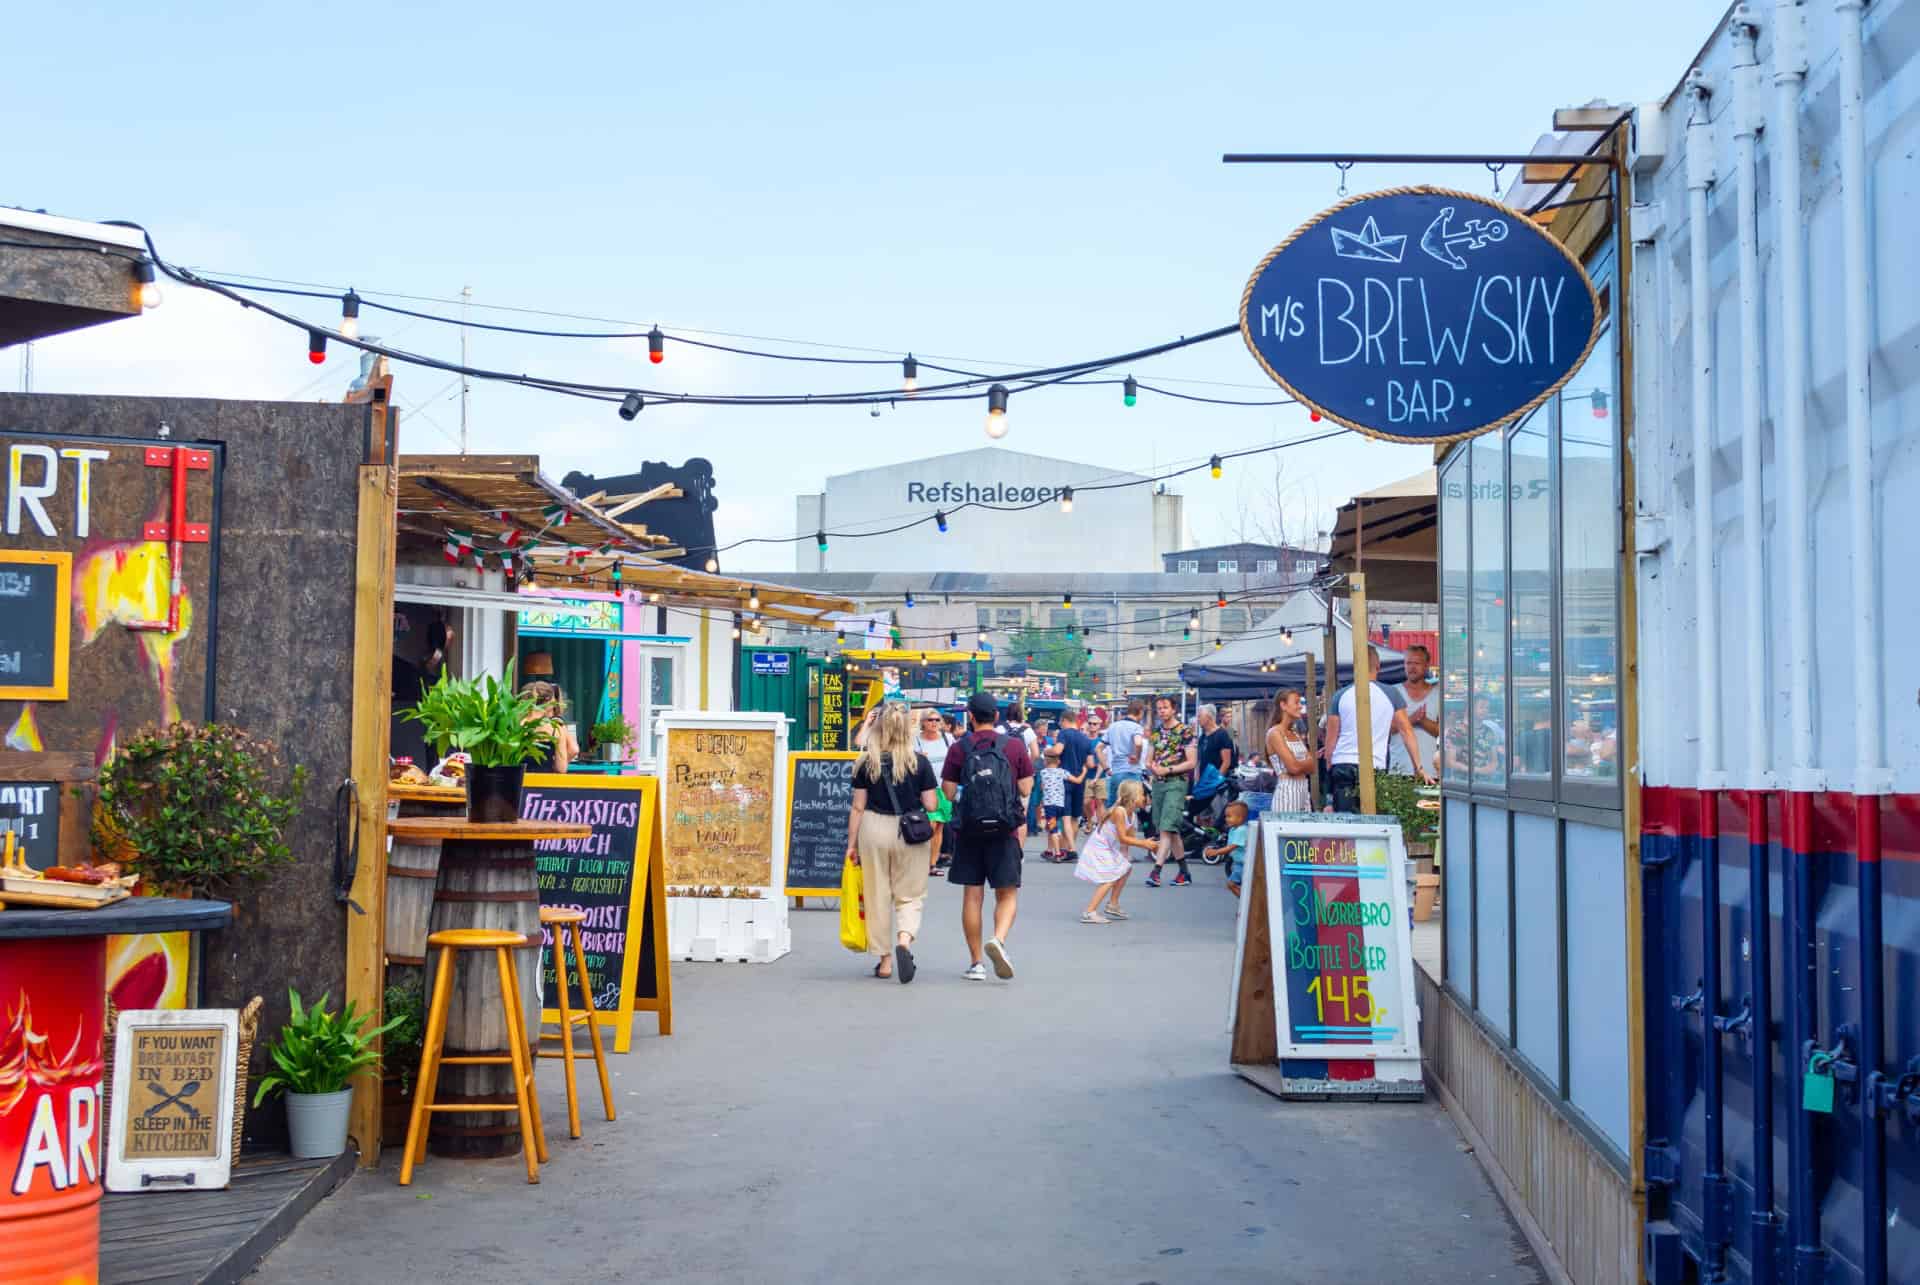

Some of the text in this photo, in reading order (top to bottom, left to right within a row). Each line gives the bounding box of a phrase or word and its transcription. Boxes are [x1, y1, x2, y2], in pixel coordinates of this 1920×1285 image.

[1260, 275, 1566, 366] M/S BREWSKY
[1387, 379, 1455, 423] BAR
[0, 444, 110, 537] RT
[800, 762, 856, 779] MAROC
[819, 782, 852, 797] MAR
[533, 833, 611, 856] ANDWICH
[1284, 840, 1320, 863] Offer
[1323, 840, 1338, 863] of
[1340, 840, 1358, 863] the
[1290, 880, 1392, 927] 3 NØRREBRO
[139, 1036, 216, 1049] IF YOU WANT
[138, 1051, 215, 1066] BREAKFAST
[138, 1067, 213, 1080] IN BED
[134, 1116, 211, 1131] SLEEP IN THE
[132, 1132, 210, 1152] KITCHEN
